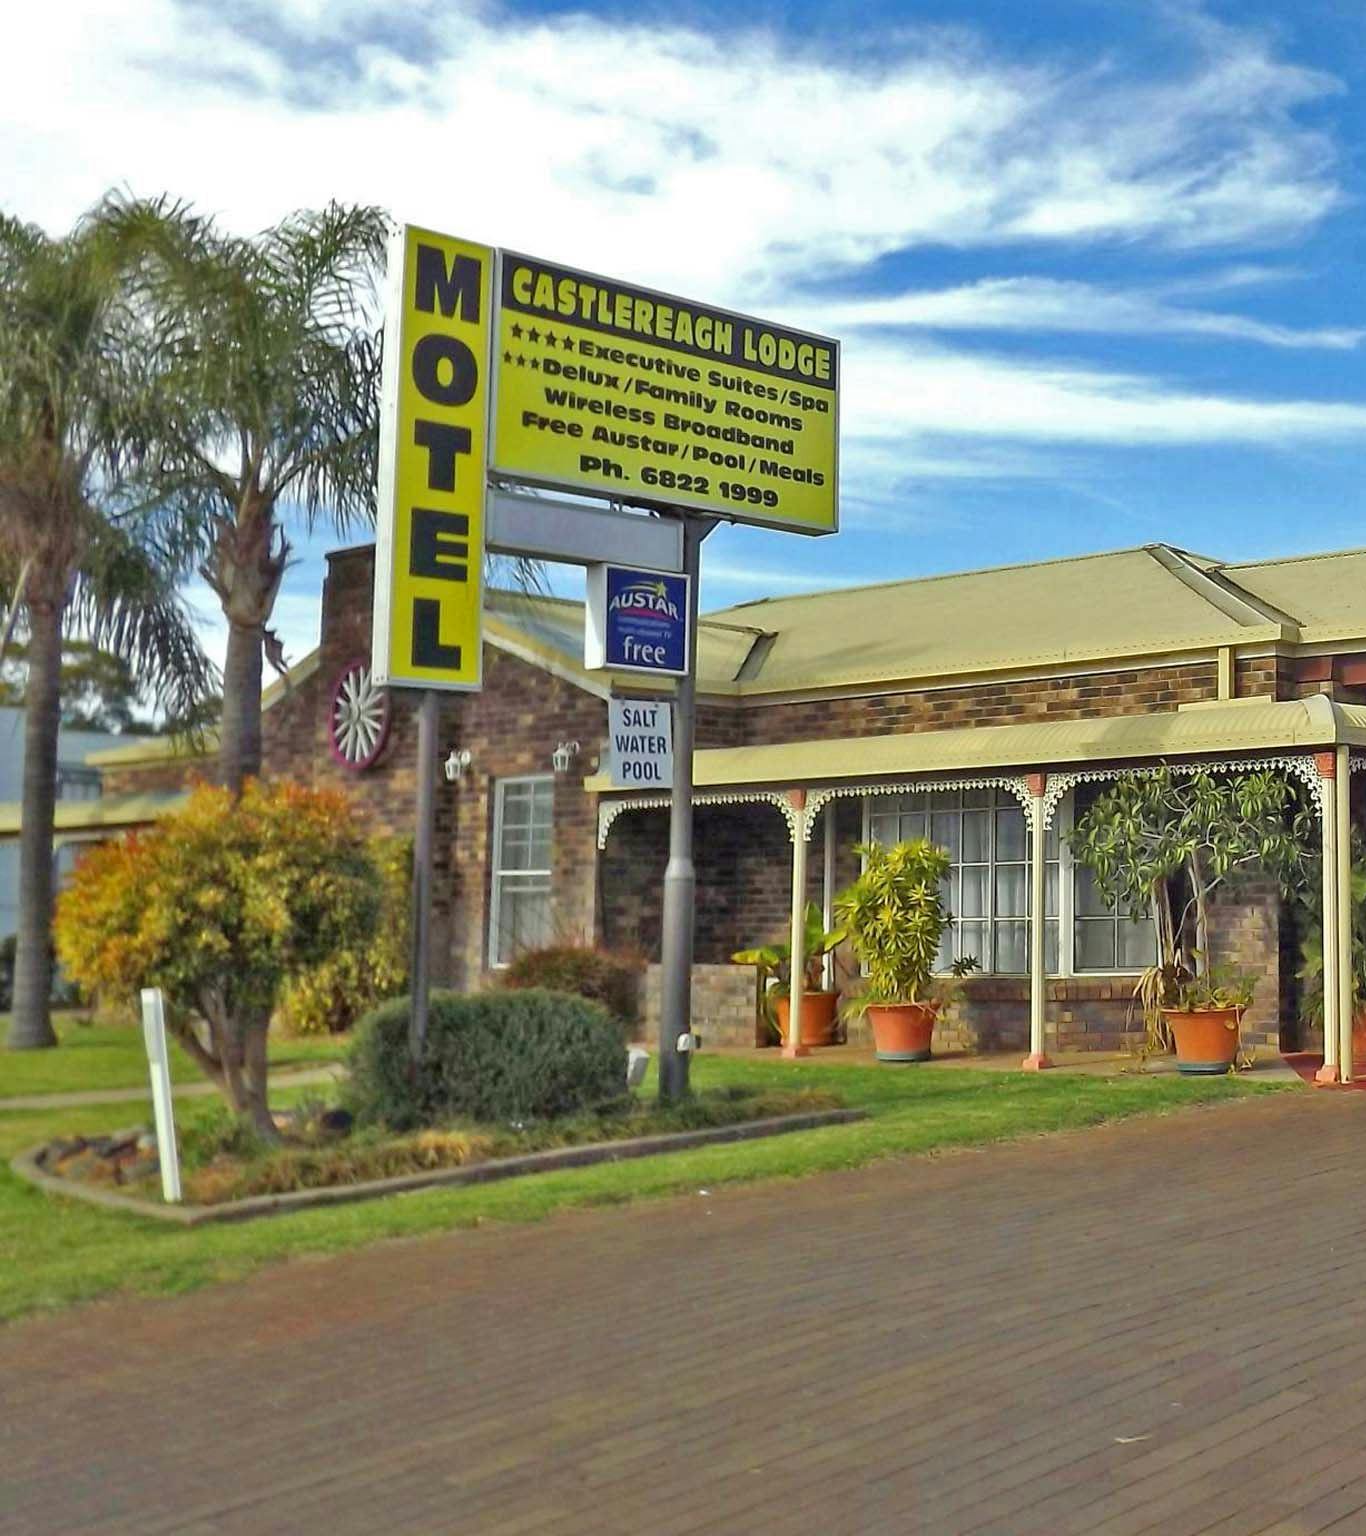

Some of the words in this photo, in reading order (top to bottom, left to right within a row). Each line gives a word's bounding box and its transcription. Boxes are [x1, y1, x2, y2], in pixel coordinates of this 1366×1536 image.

[513, 267, 733, 355] CASTLEREAGH
[744, 329, 830, 380] LODGE
[543, 358, 717, 414] Delux/Family
[725, 400, 803, 431] Rooms
[579, 339, 701, 382] Executive
[708, 370, 829, 413] Suites/Spa
[522, 411, 583, 437] Free
[544, 387, 656, 425] Wireless
[664, 413, 794, 455] Broadband
[409, 243, 481, 670] MOTEL
[580, 455, 630, 480] Ph.
[641, 467, 710, 494] 6822
[719, 482, 779, 507] 1999
[609, 592, 679, 620] AUSTAR
[622, 635, 666, 664] free
[623, 708, 658, 728] SALT
[615, 735, 667, 754] WATER
[622, 761, 662, 781] POOL
